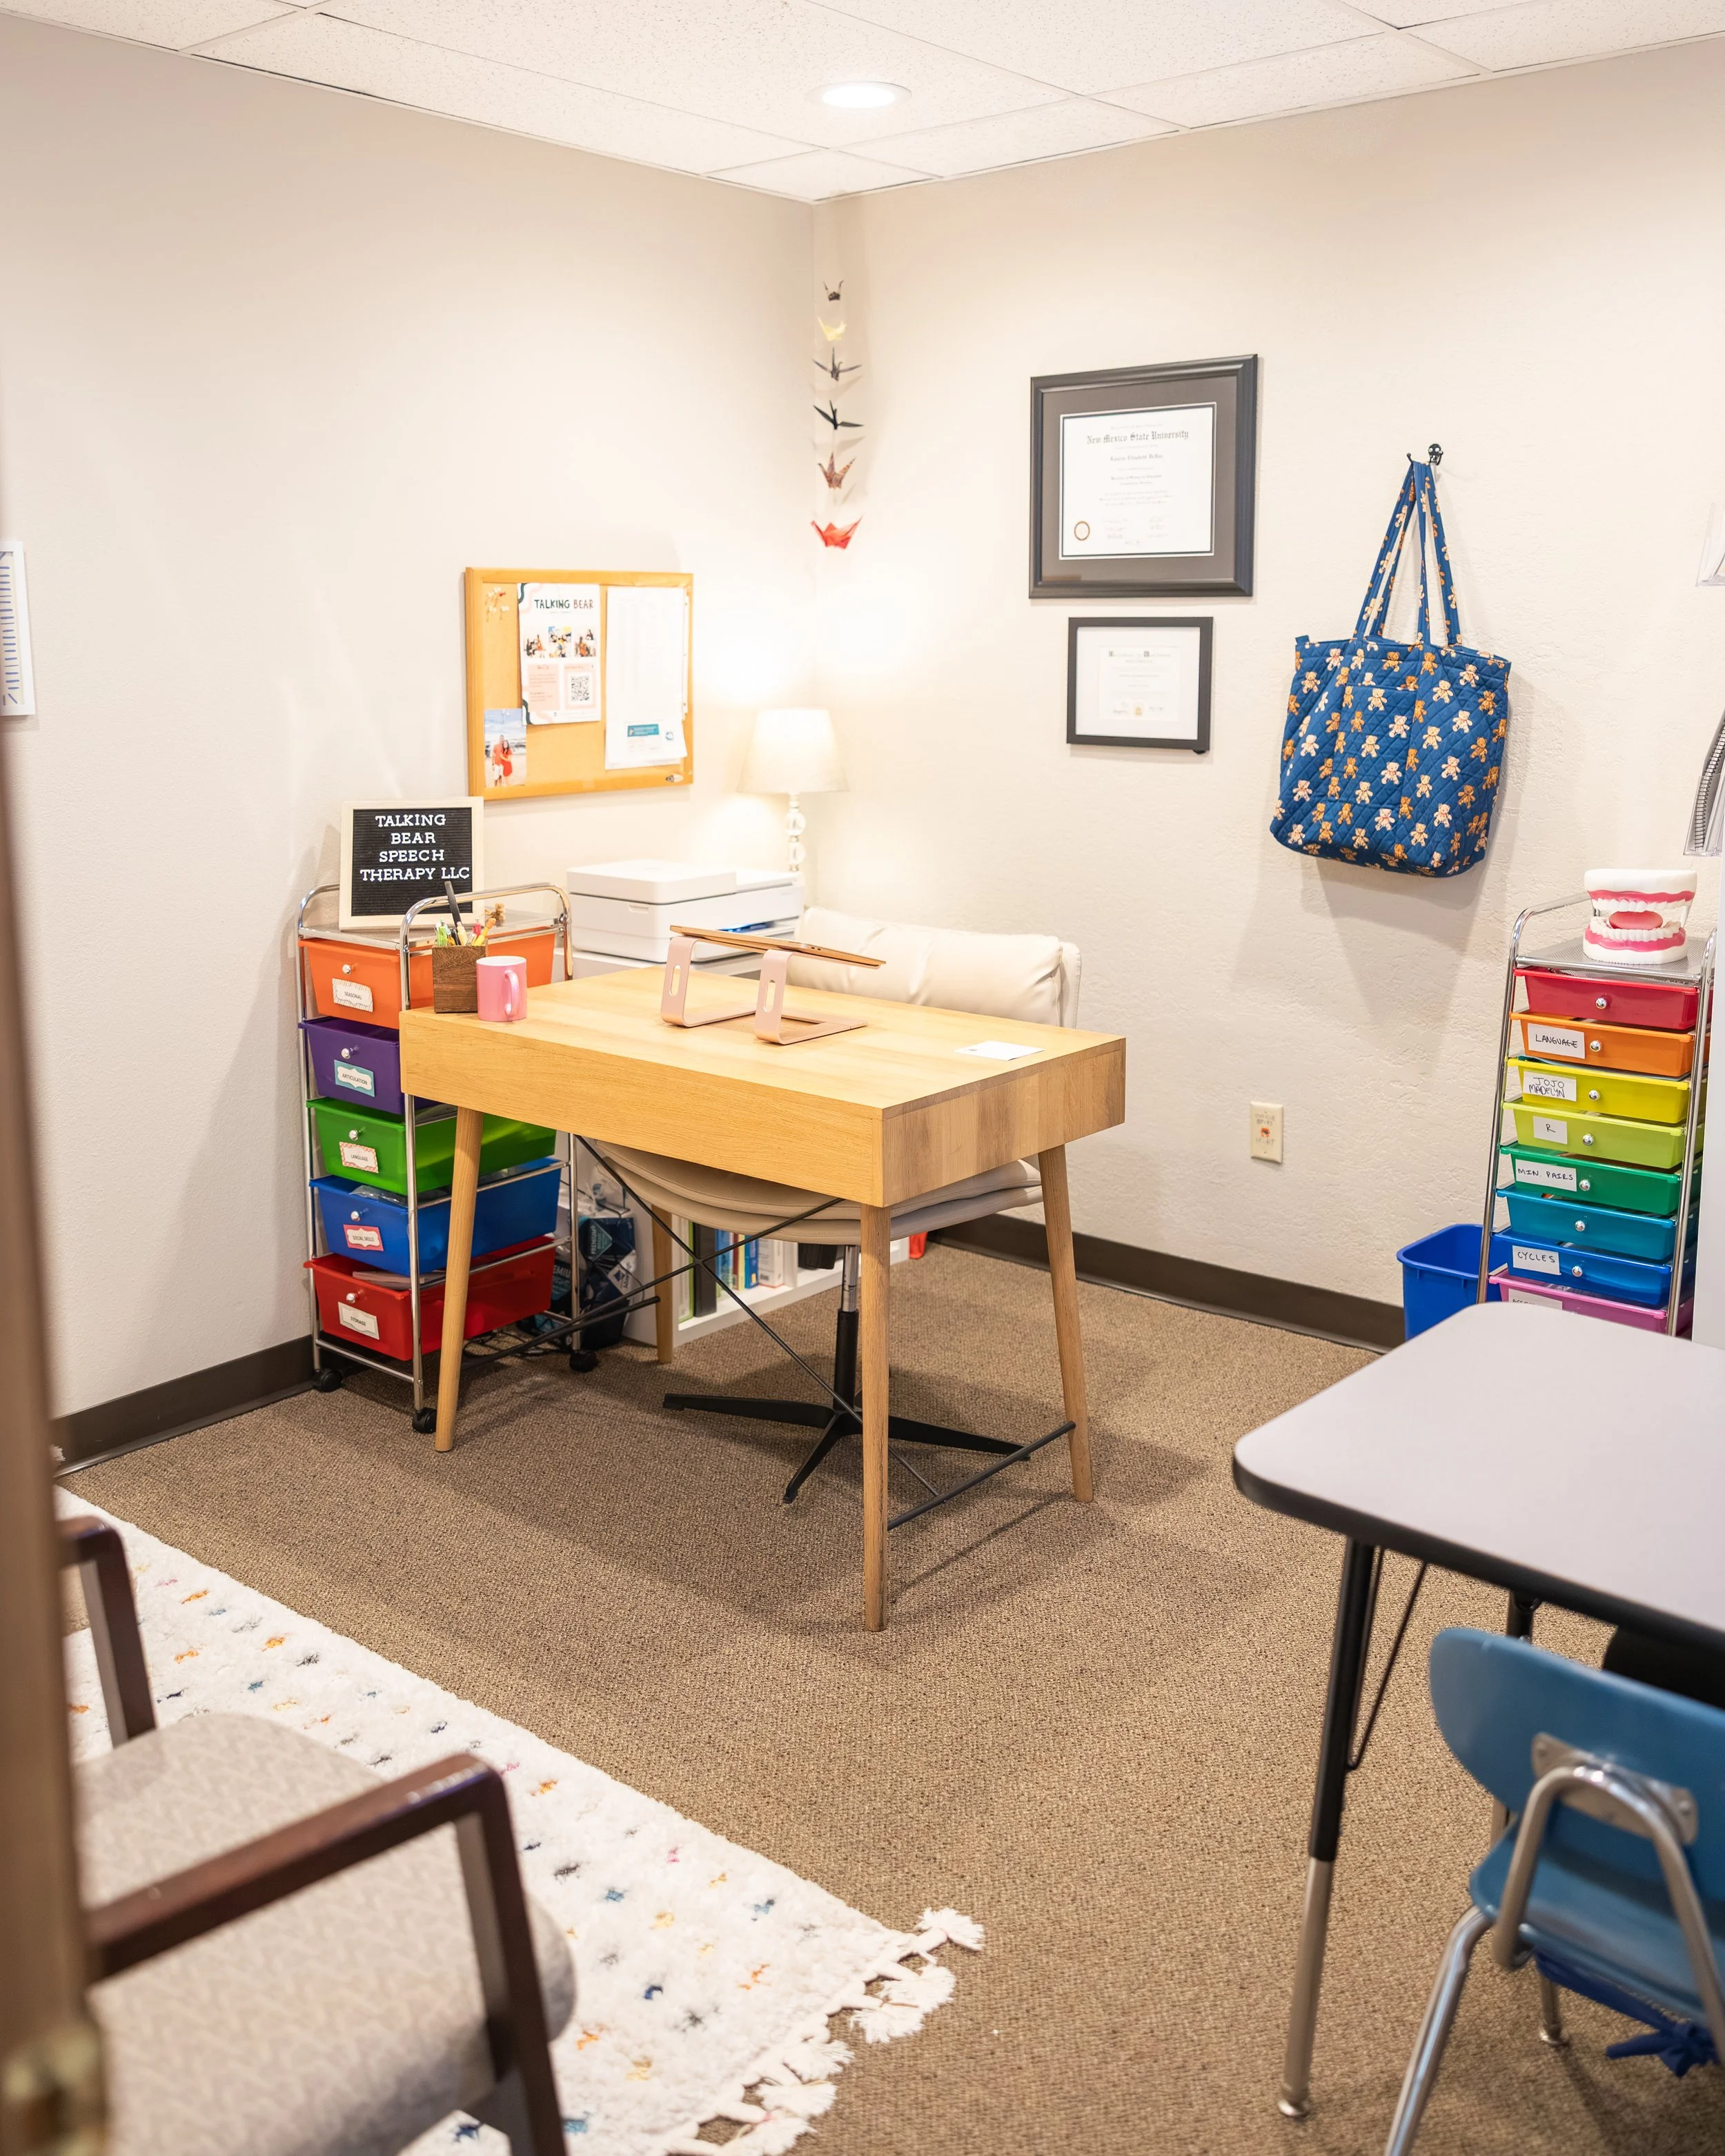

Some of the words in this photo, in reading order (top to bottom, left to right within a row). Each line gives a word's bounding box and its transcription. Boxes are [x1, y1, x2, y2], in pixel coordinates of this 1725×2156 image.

[1087, 435, 1102, 444] New
[1103, 434, 1127, 444] Mexico
[1130, 432, 1150, 442] State
[1151, 430, 1190, 441] University
[534, 600, 570, 609] TALKING
[573, 599, 593, 609] BEAR
[375, 813, 446, 827] TALKING
[391, 832, 436, 844] BEAR
[379, 849, 445, 862] SPEECH
[359, 867, 436, 882] THERAPY
[441, 867, 470, 880] LLC
[344, 991, 363, 1000] SEASONAL
[1535, 1034, 1578, 1048] LANGUAGE
[342, 1073, 368, 1085] ARTICULATION
[1533, 1077, 1565, 1089] JOJO
[1528, 1084, 1565, 1098] MADELYN
[1546, 1123, 1556, 1133] R
[1517, 1168, 1542, 1178] MIN.
[1546, 1171, 1574, 1180] PAIRS
[1517, 1252, 1555, 1263] CYCLES
[351, 1316, 366, 1327] STORAGE
